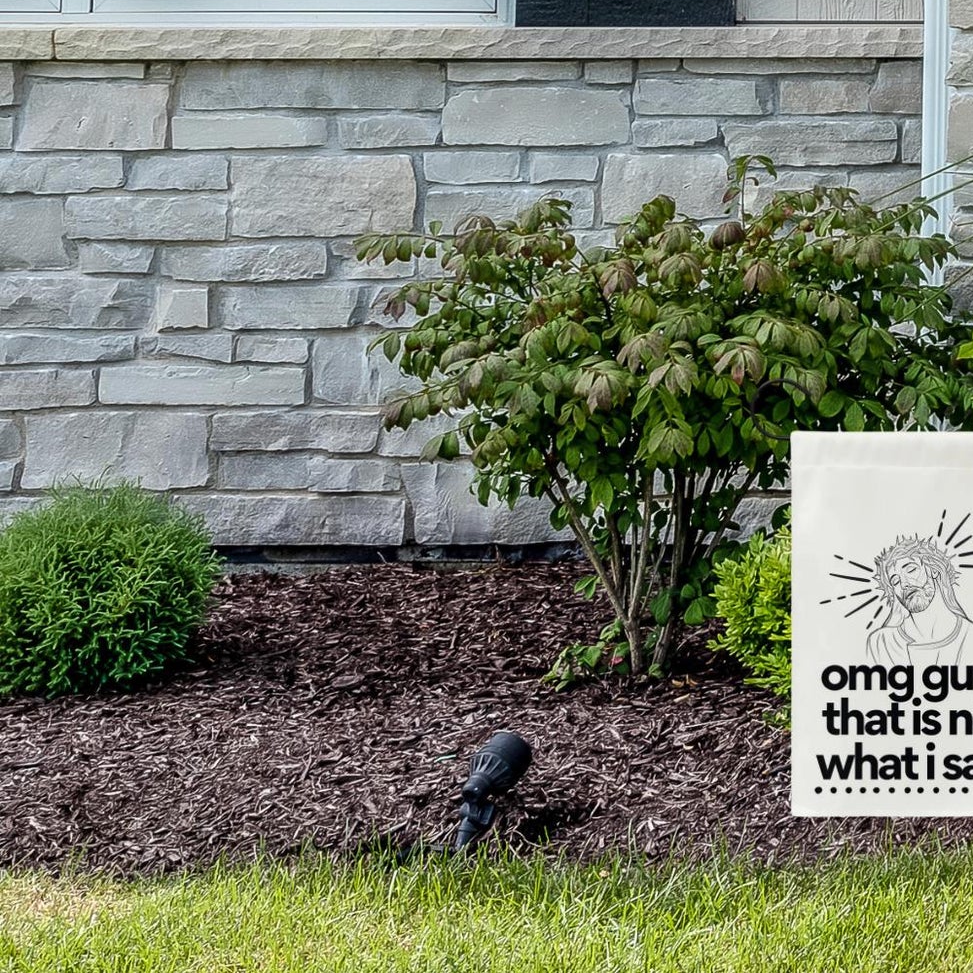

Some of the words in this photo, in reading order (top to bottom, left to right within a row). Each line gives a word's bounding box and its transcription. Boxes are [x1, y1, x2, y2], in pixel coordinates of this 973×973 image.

[821, 664, 915, 703] omg
[822, 697, 905, 736] that
[911, 697, 942, 736] is
[816, 741, 919, 780] what
[926, 741, 936, 780] i
